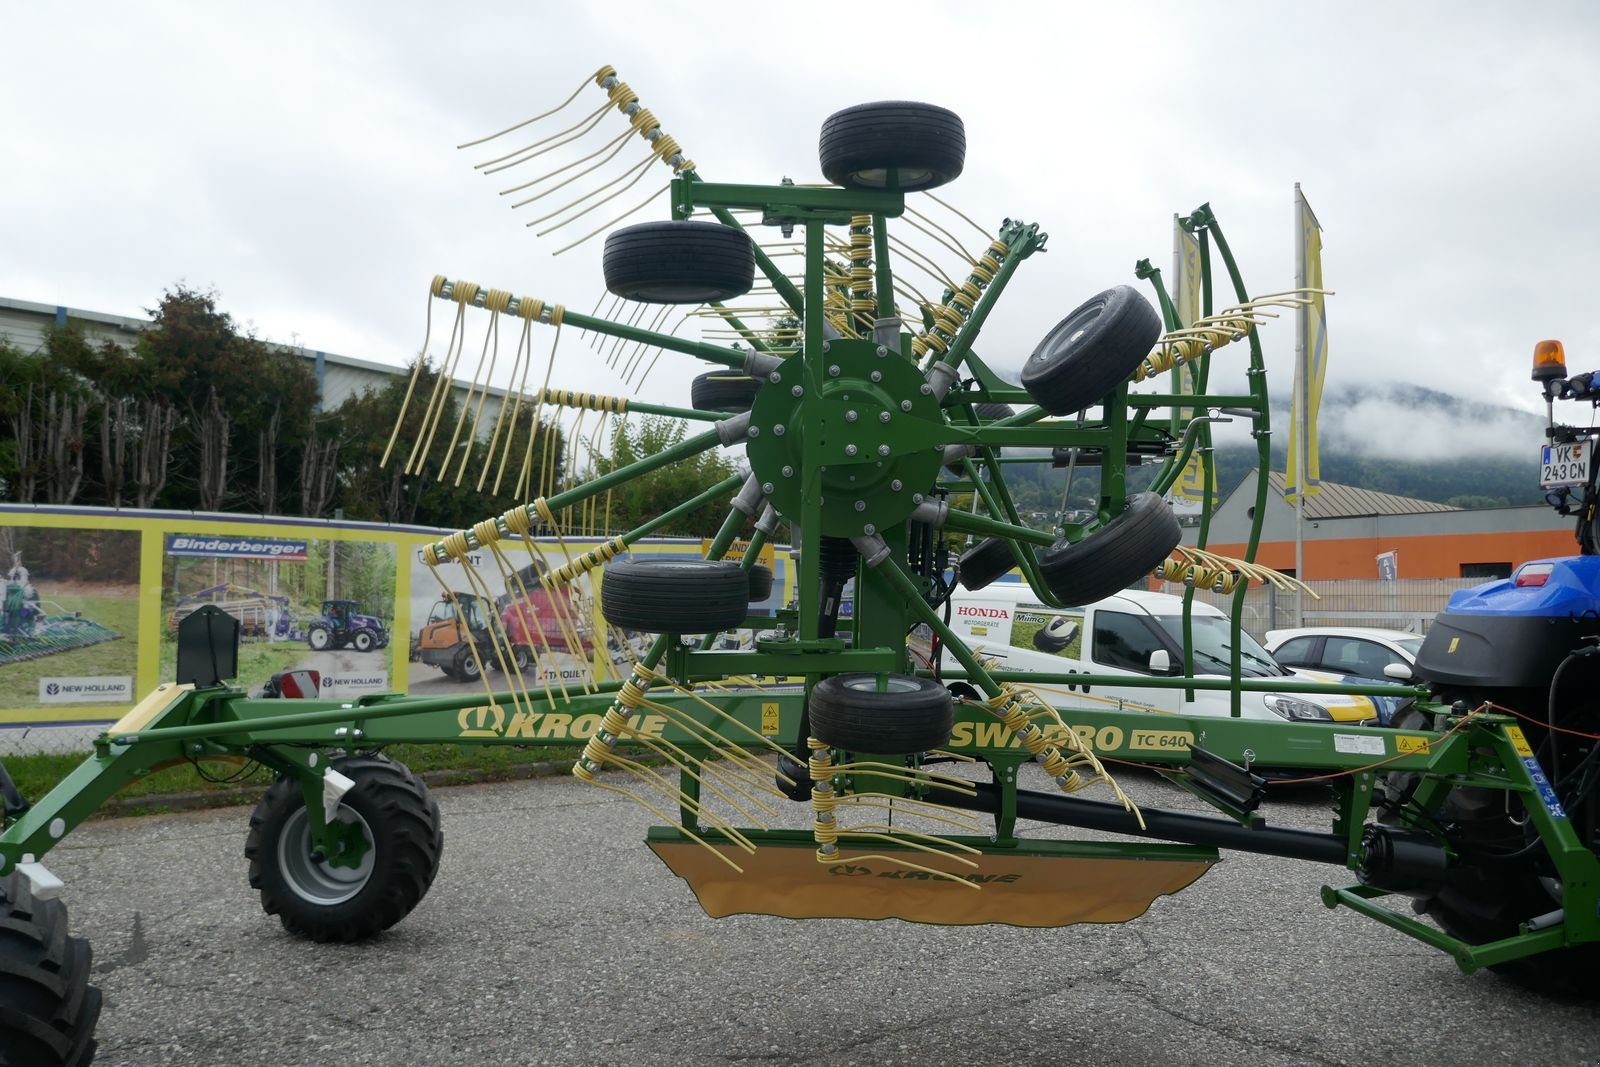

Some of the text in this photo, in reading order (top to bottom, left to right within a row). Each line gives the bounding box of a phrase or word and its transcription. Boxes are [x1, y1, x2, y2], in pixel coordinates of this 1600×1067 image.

[1556, 446, 1571, 463] VK
[1544, 462, 1586, 481] 243 CN
[172, 538, 305, 555] Binderberger
[957, 606, 1009, 619] HONDA
[62, 684, 126, 693] NEW HOLLAND
[351, 677, 383, 685] HOLLAND
[948, 721, 1187, 752] SWDRO TC 640
